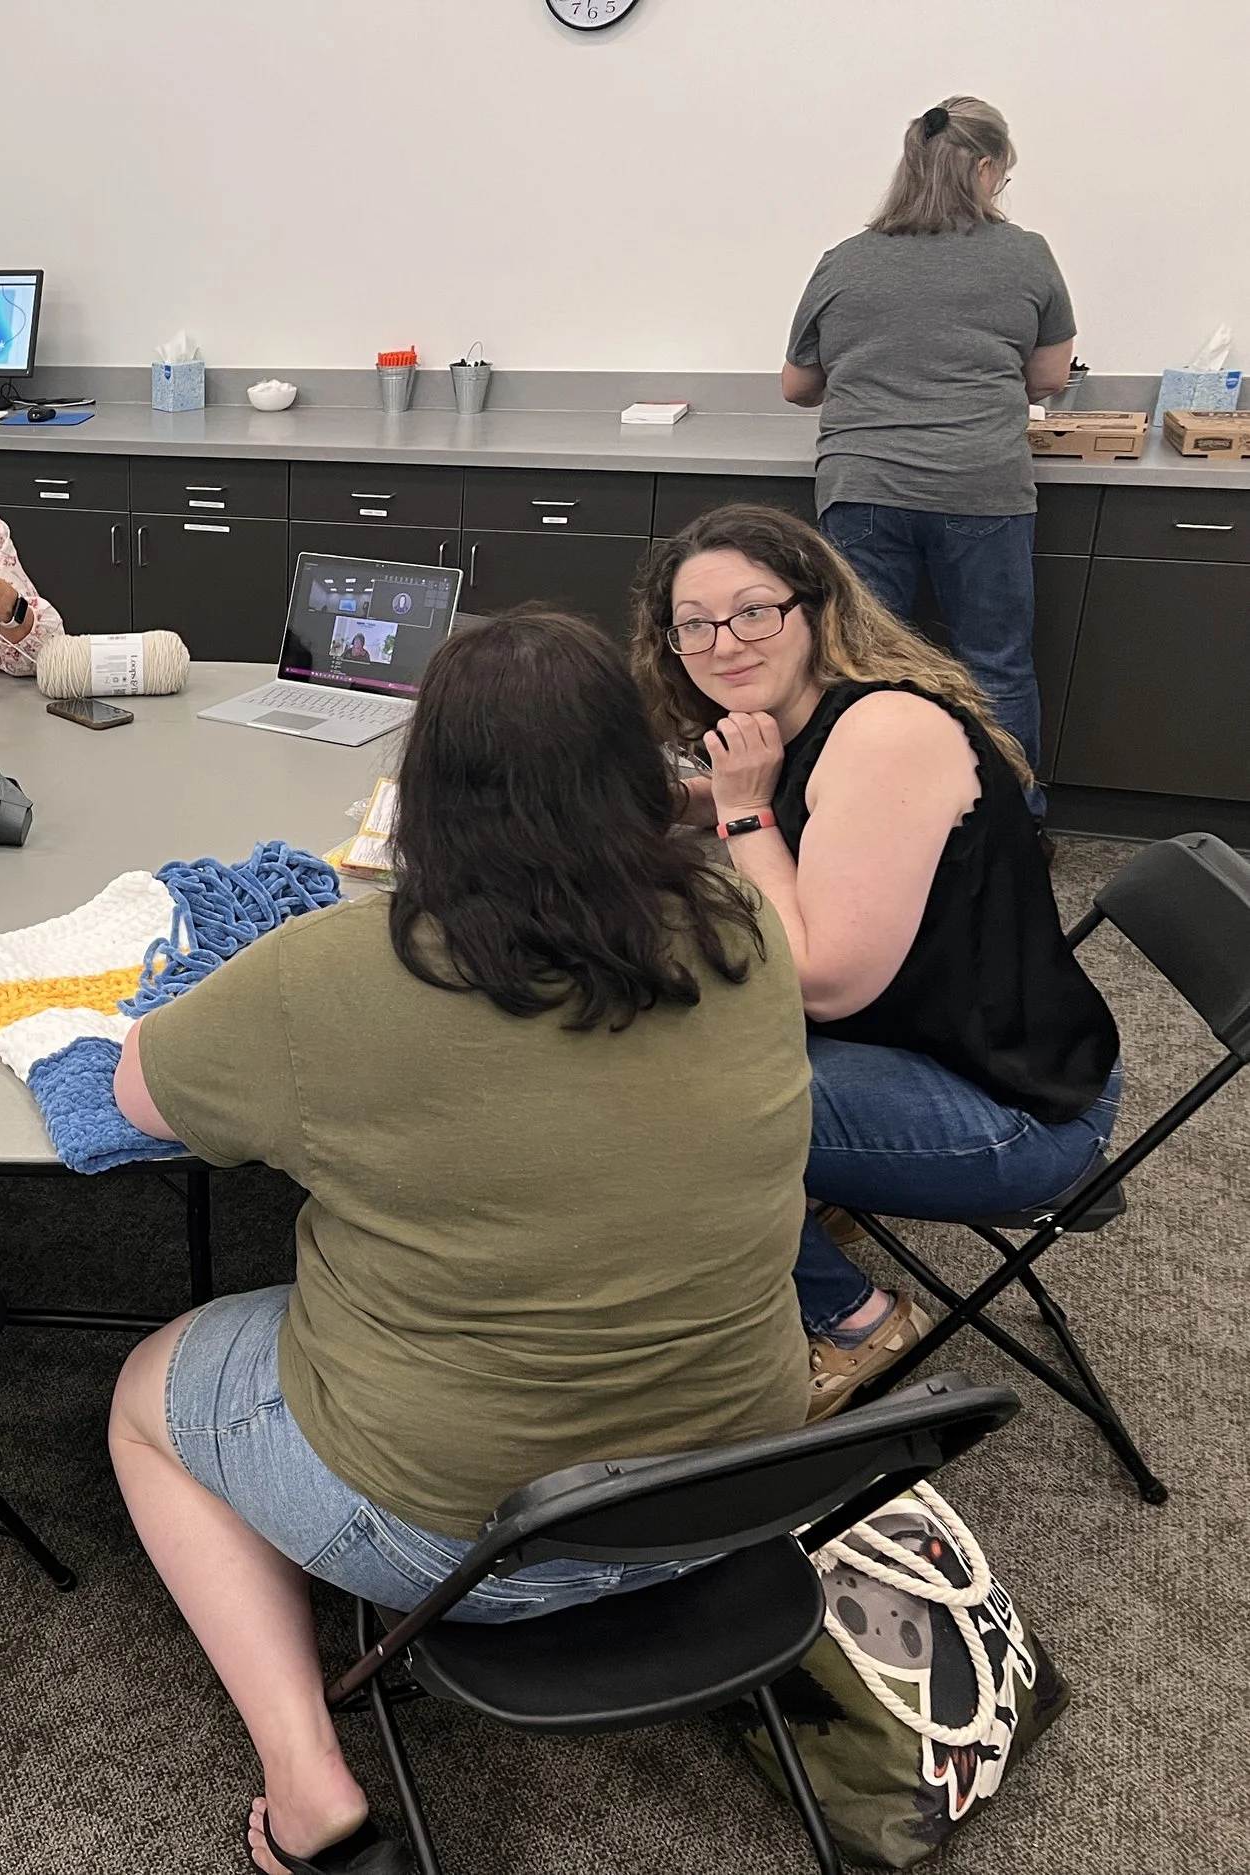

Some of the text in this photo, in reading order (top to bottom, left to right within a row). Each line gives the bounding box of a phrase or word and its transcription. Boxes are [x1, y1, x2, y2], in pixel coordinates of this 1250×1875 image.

[572, 2, 581, 15] 7
[587, 6, 598, 19] 6
[605, 1, 616, 13] 5
